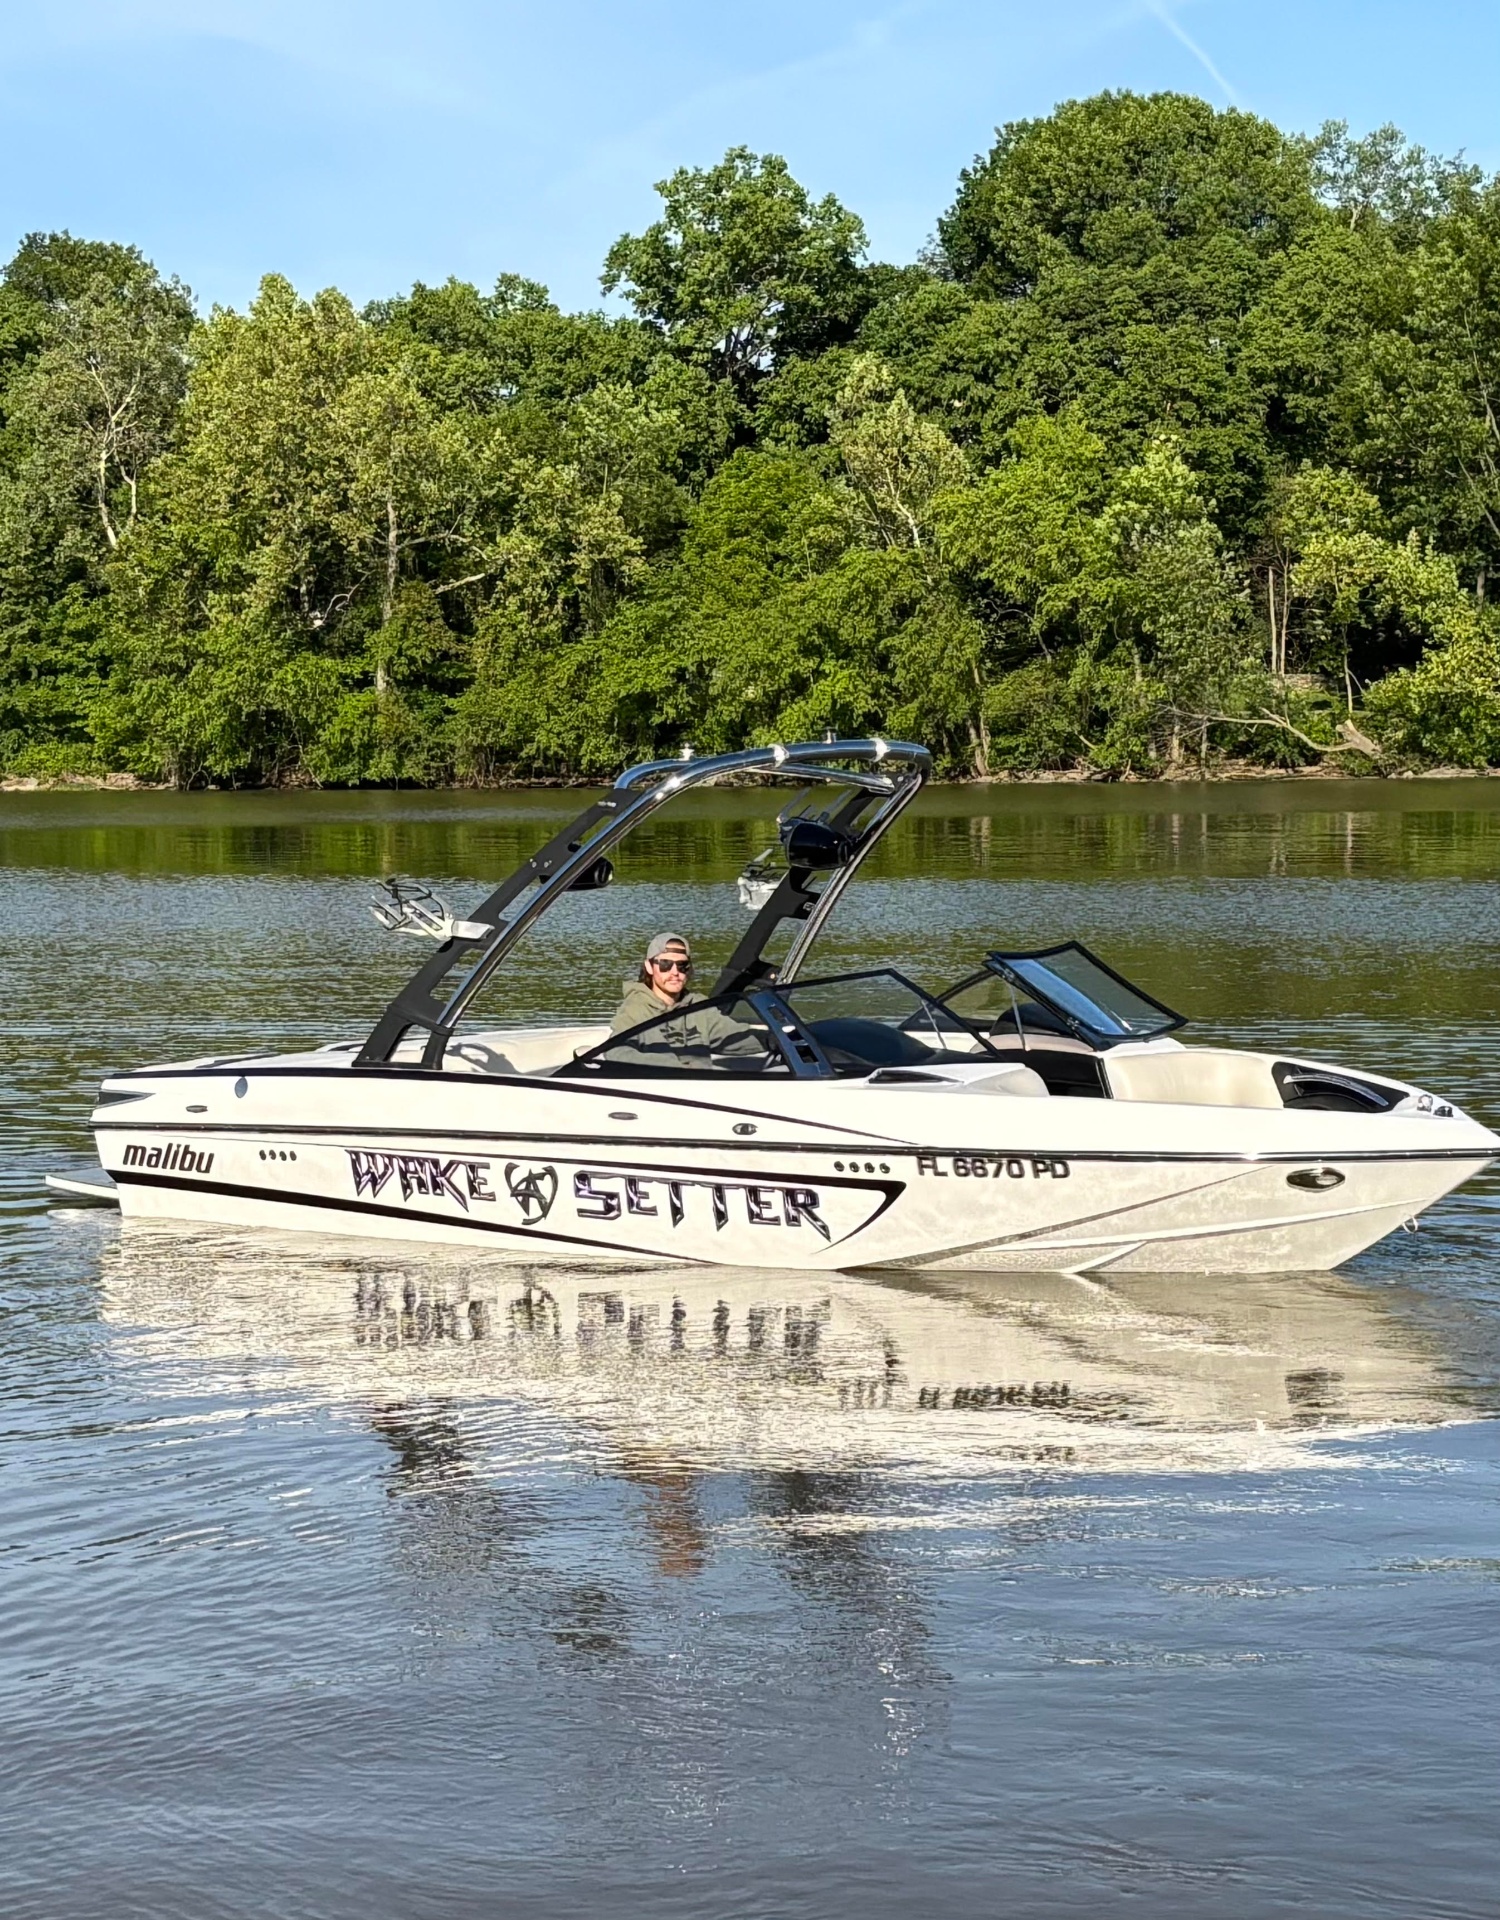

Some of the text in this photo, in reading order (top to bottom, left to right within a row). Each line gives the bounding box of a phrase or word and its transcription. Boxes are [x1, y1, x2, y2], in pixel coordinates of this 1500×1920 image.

[122, 1143, 214, 1174] malibu
[916, 1156, 1070, 1179] FL 6670 PD
[345, 1149, 496, 1212] WAKE
[574, 1170, 831, 1242] SETTER
